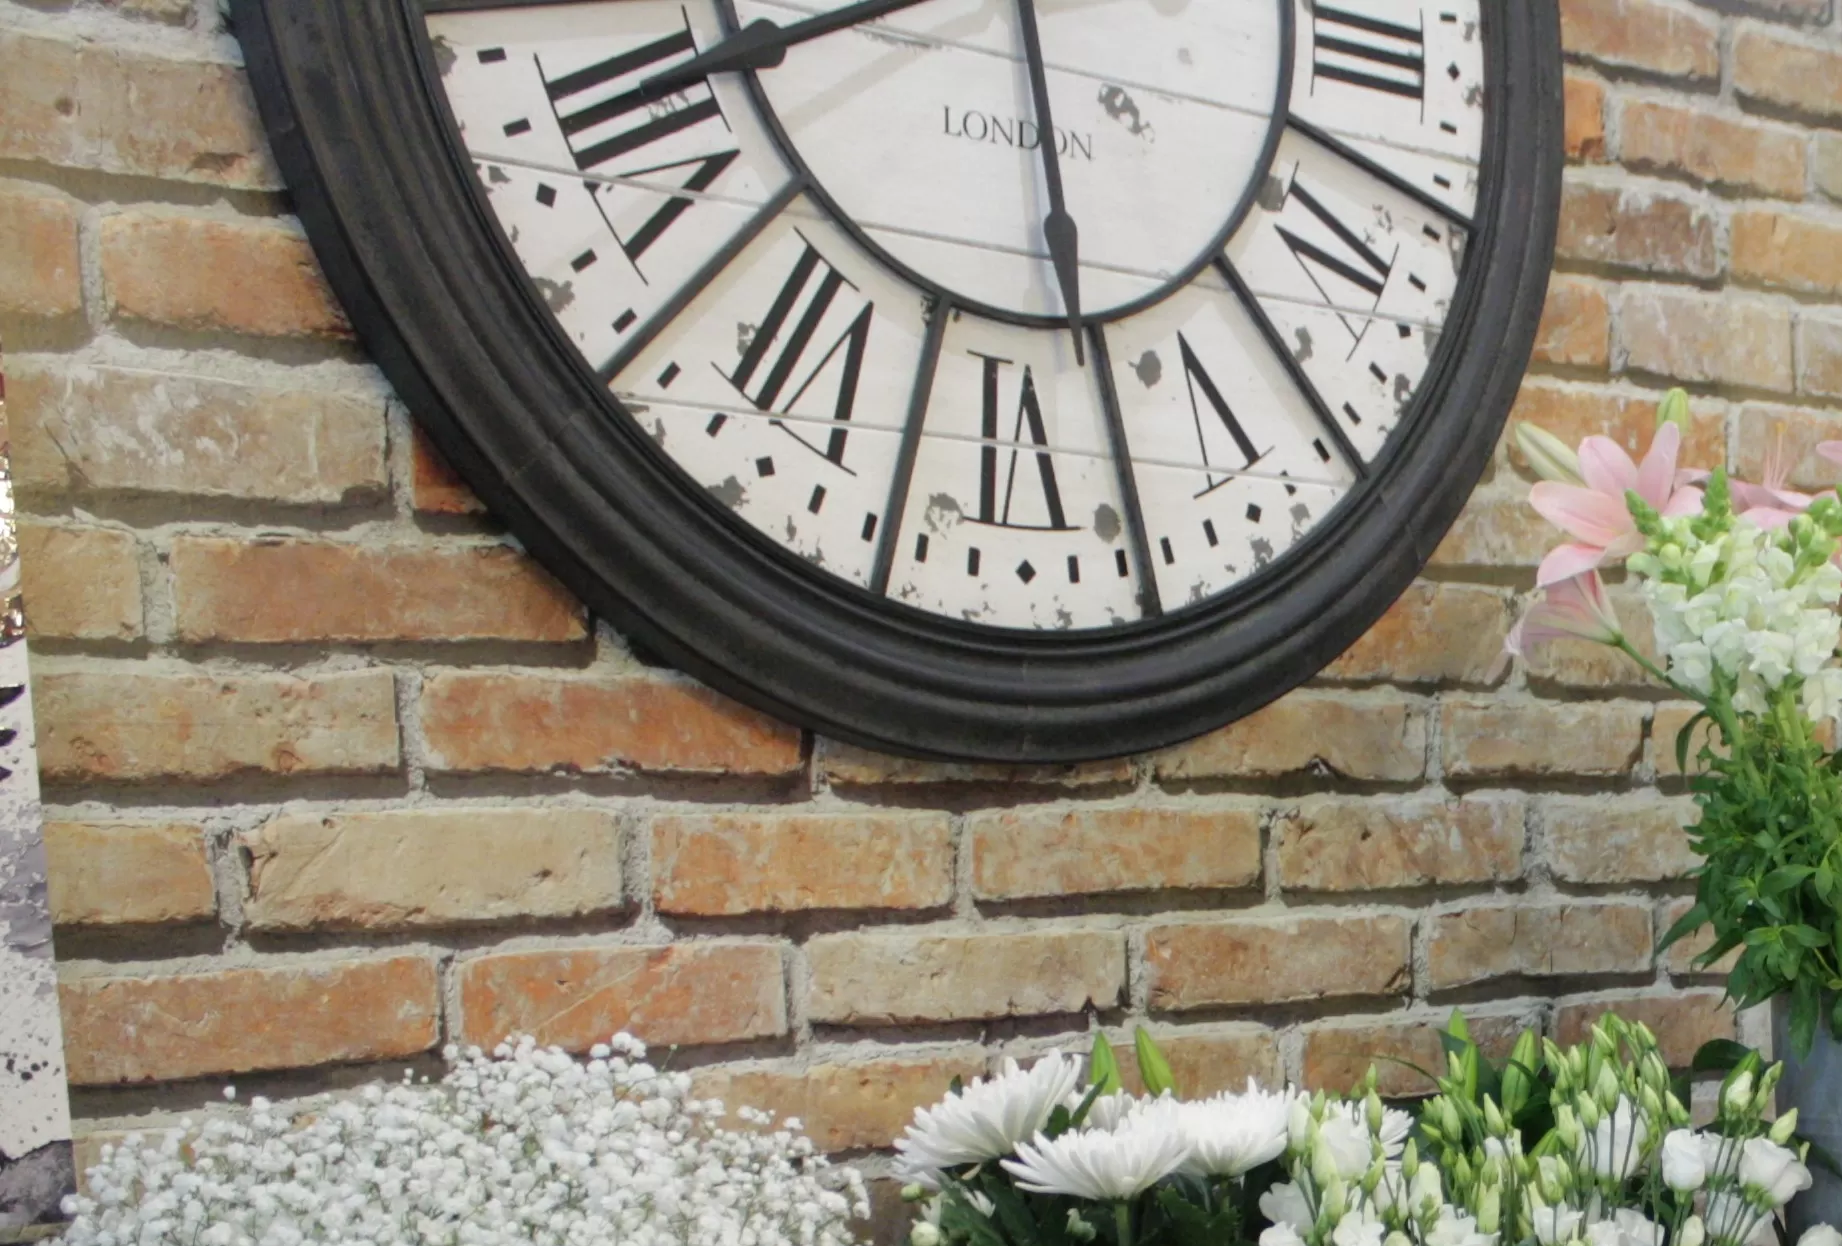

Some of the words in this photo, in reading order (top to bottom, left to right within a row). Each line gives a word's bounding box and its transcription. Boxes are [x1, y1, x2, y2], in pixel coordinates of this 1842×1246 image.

[942, 105, 1094, 161] LONDON
[711, 226, 873, 477] VII
[1177, 330, 1275, 499] V
[963, 350, 1084, 530] VI
